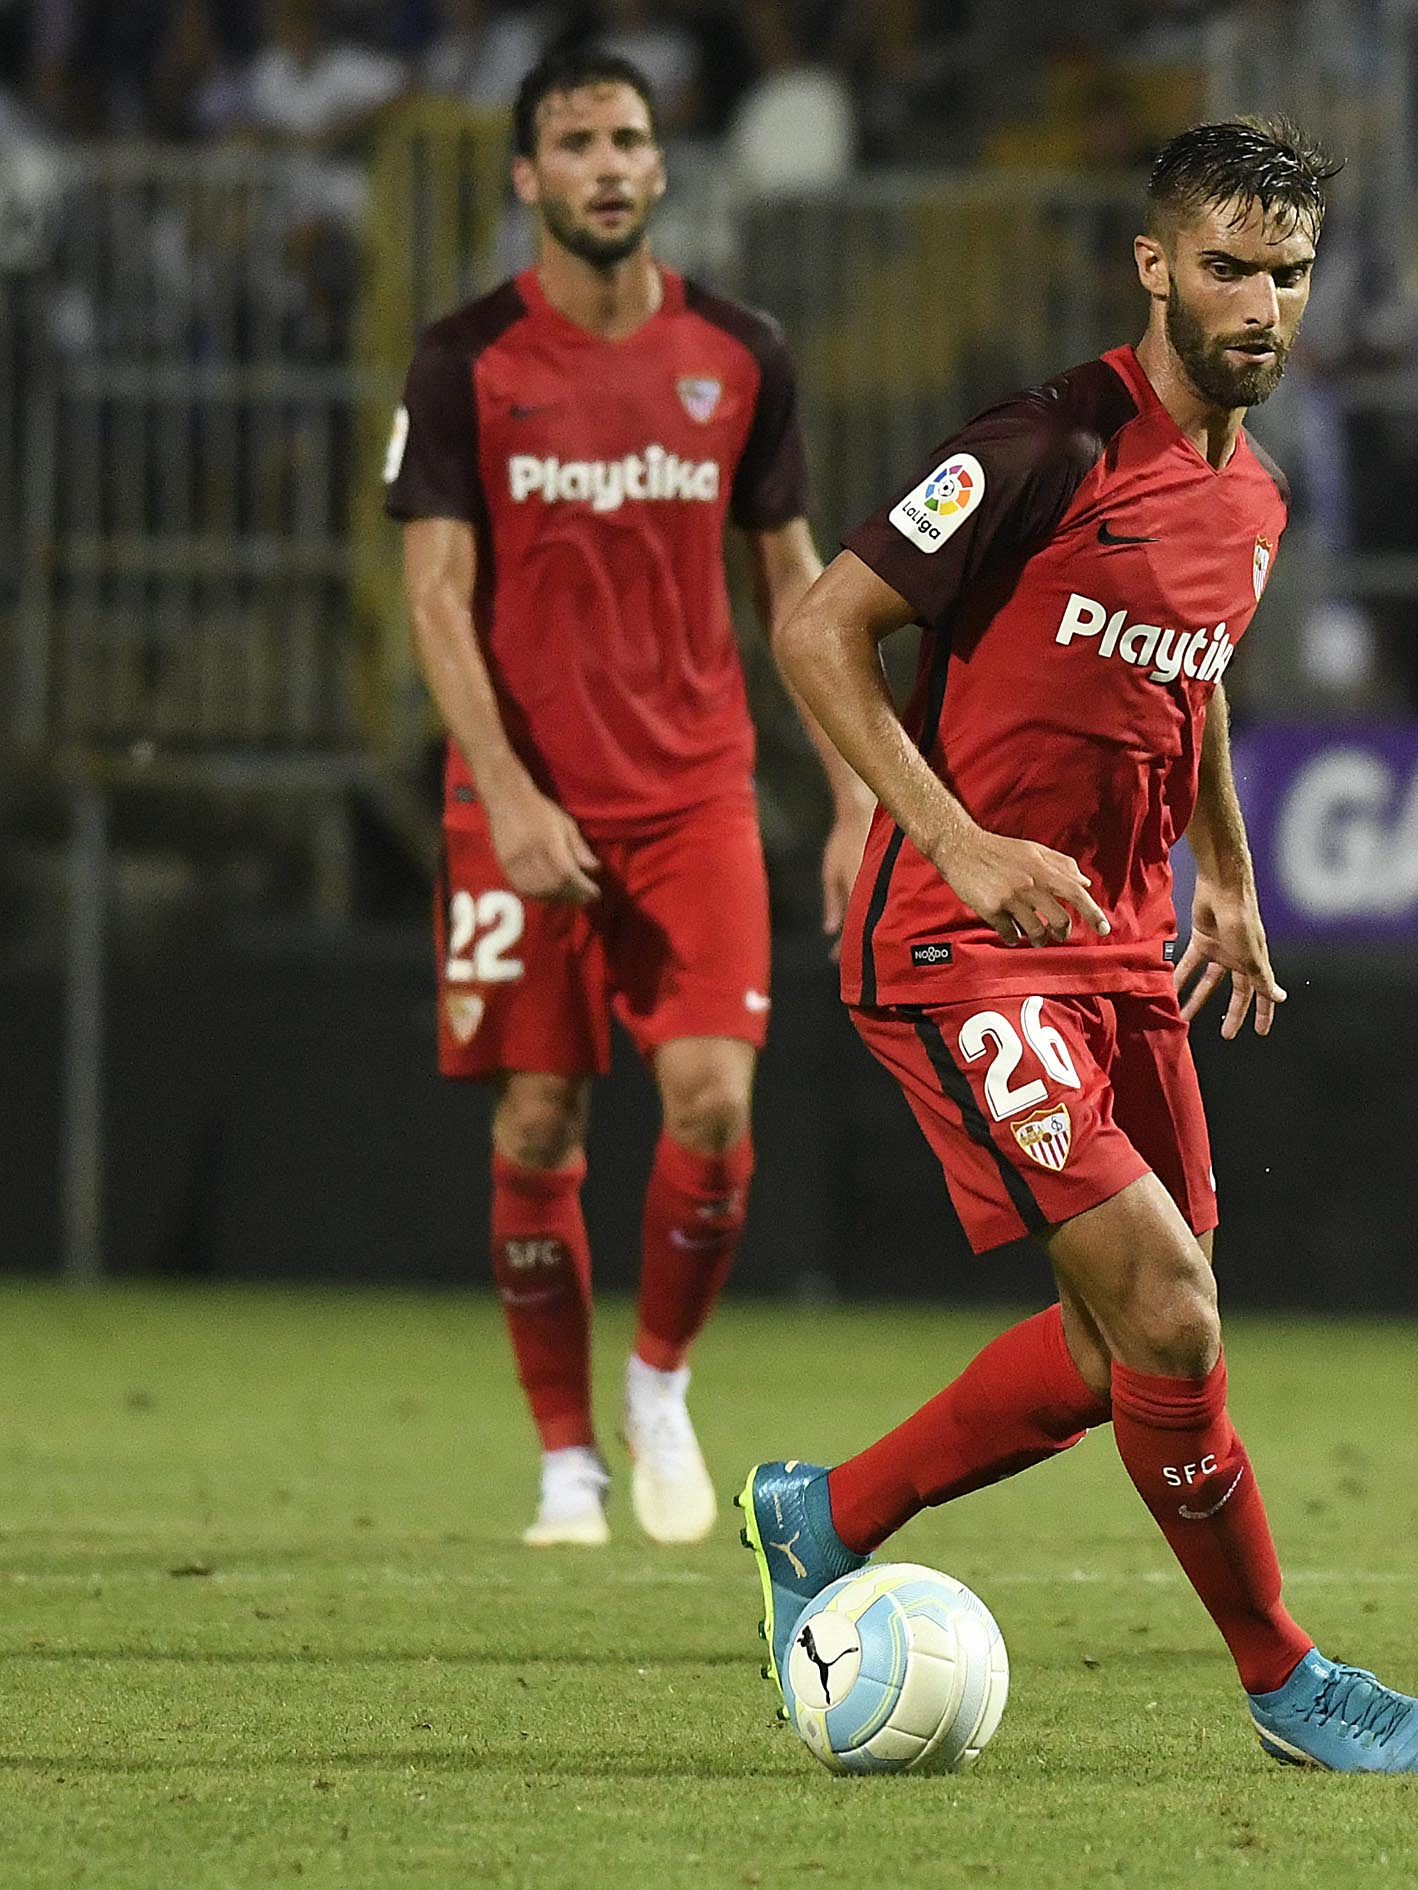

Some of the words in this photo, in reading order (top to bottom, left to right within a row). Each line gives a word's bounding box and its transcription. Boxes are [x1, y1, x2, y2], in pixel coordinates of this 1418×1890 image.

[508, 444, 720, 513] Playtika
[902, 501, 941, 540] LaLiga
[1055, 593, 1234, 686] Playtik
[446, 889, 525, 983] 22
[958, 995, 1081, 1122] 26
[1162, 1453, 1218, 1486] SFC
